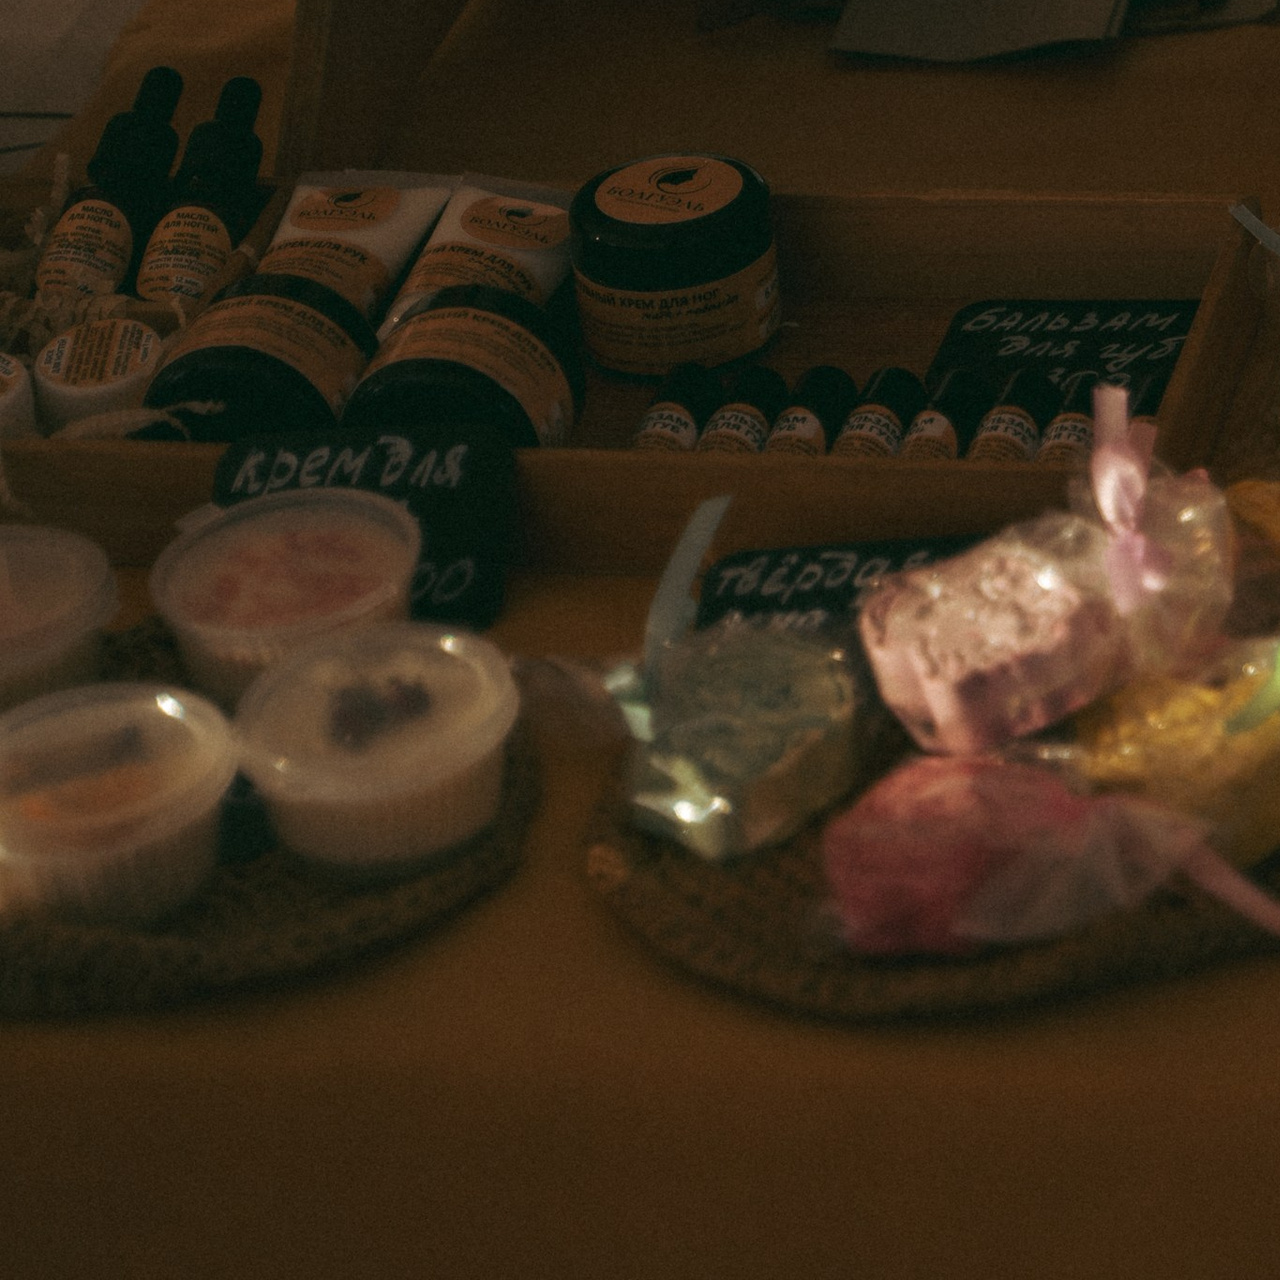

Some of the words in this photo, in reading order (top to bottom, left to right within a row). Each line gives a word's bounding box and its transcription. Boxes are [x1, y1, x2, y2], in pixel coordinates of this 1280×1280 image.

[607, 186, 705, 212] БОЛГУЭЛЬ
[82, 206, 113, 218] МАСЛО
[176, 213, 210, 222] МАСЛО
[67, 213, 85, 222] ДЛЯ
[86, 214, 121, 230] НОГТЕЙ
[163, 220, 181, 230] ДЛЯ
[182, 221, 218, 234] НОГТЕЙ
[449, 244, 485, 258] КРЕМ
[619, 296, 655, 310] КРЕМ
[659, 296, 689, 311] ДЛЯ
[692, 288, 720, 304] НОГ
[961, 306, 1182, 332] БАЛЬЗАМ
